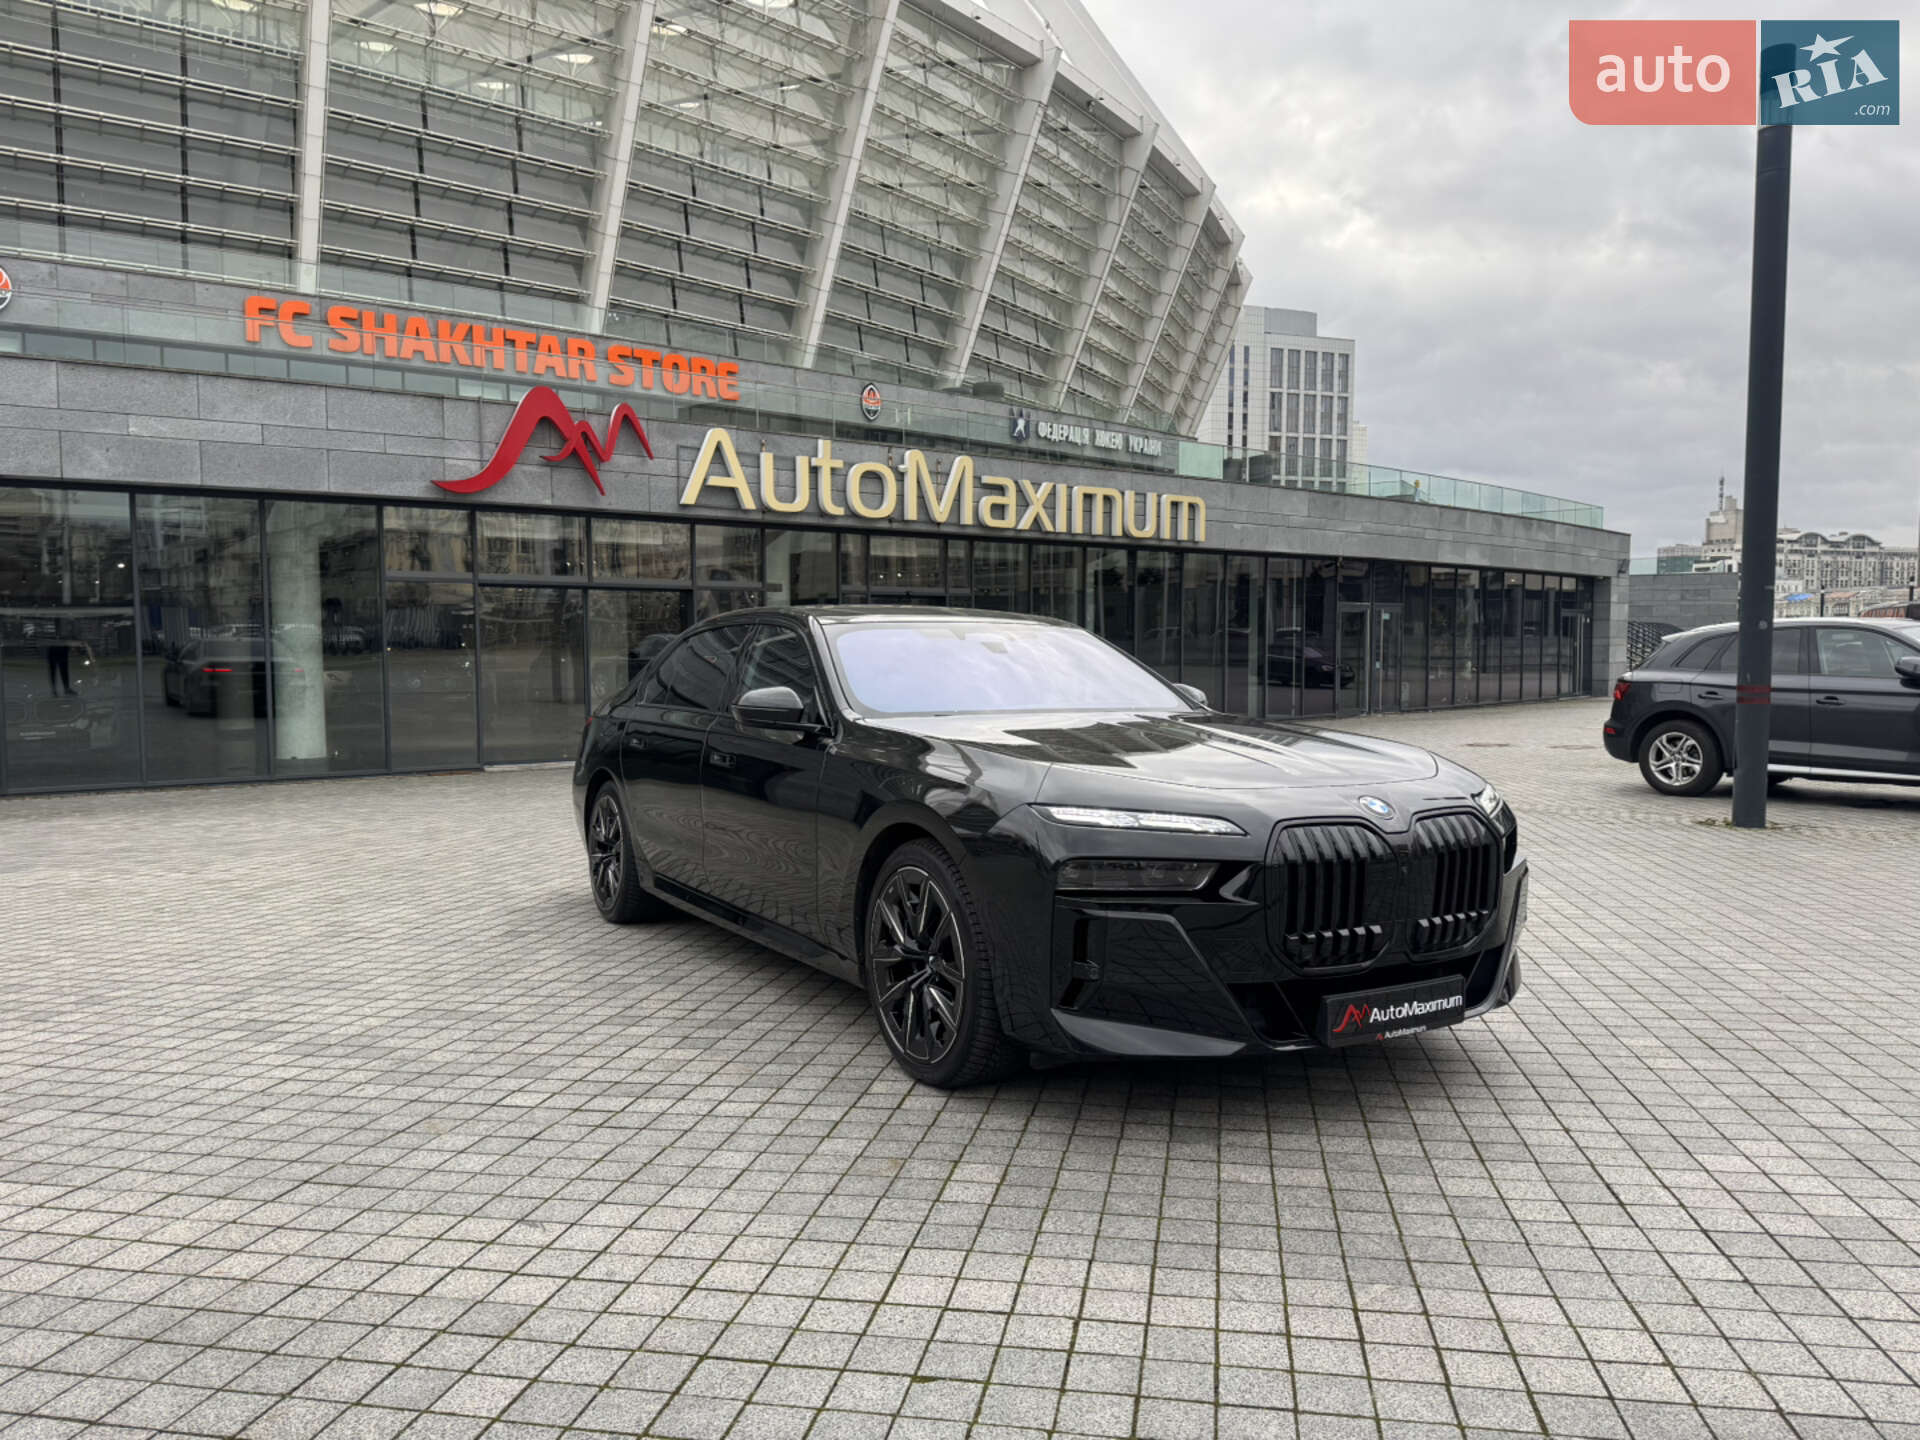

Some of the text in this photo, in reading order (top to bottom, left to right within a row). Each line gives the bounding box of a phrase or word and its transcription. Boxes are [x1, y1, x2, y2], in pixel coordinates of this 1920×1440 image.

[244, 295, 741, 401] FC SHAKHTAR STORE
[680, 427, 1207, 542] AutoMaximum
[1369, 995, 1463, 1024] AutoMaximum
